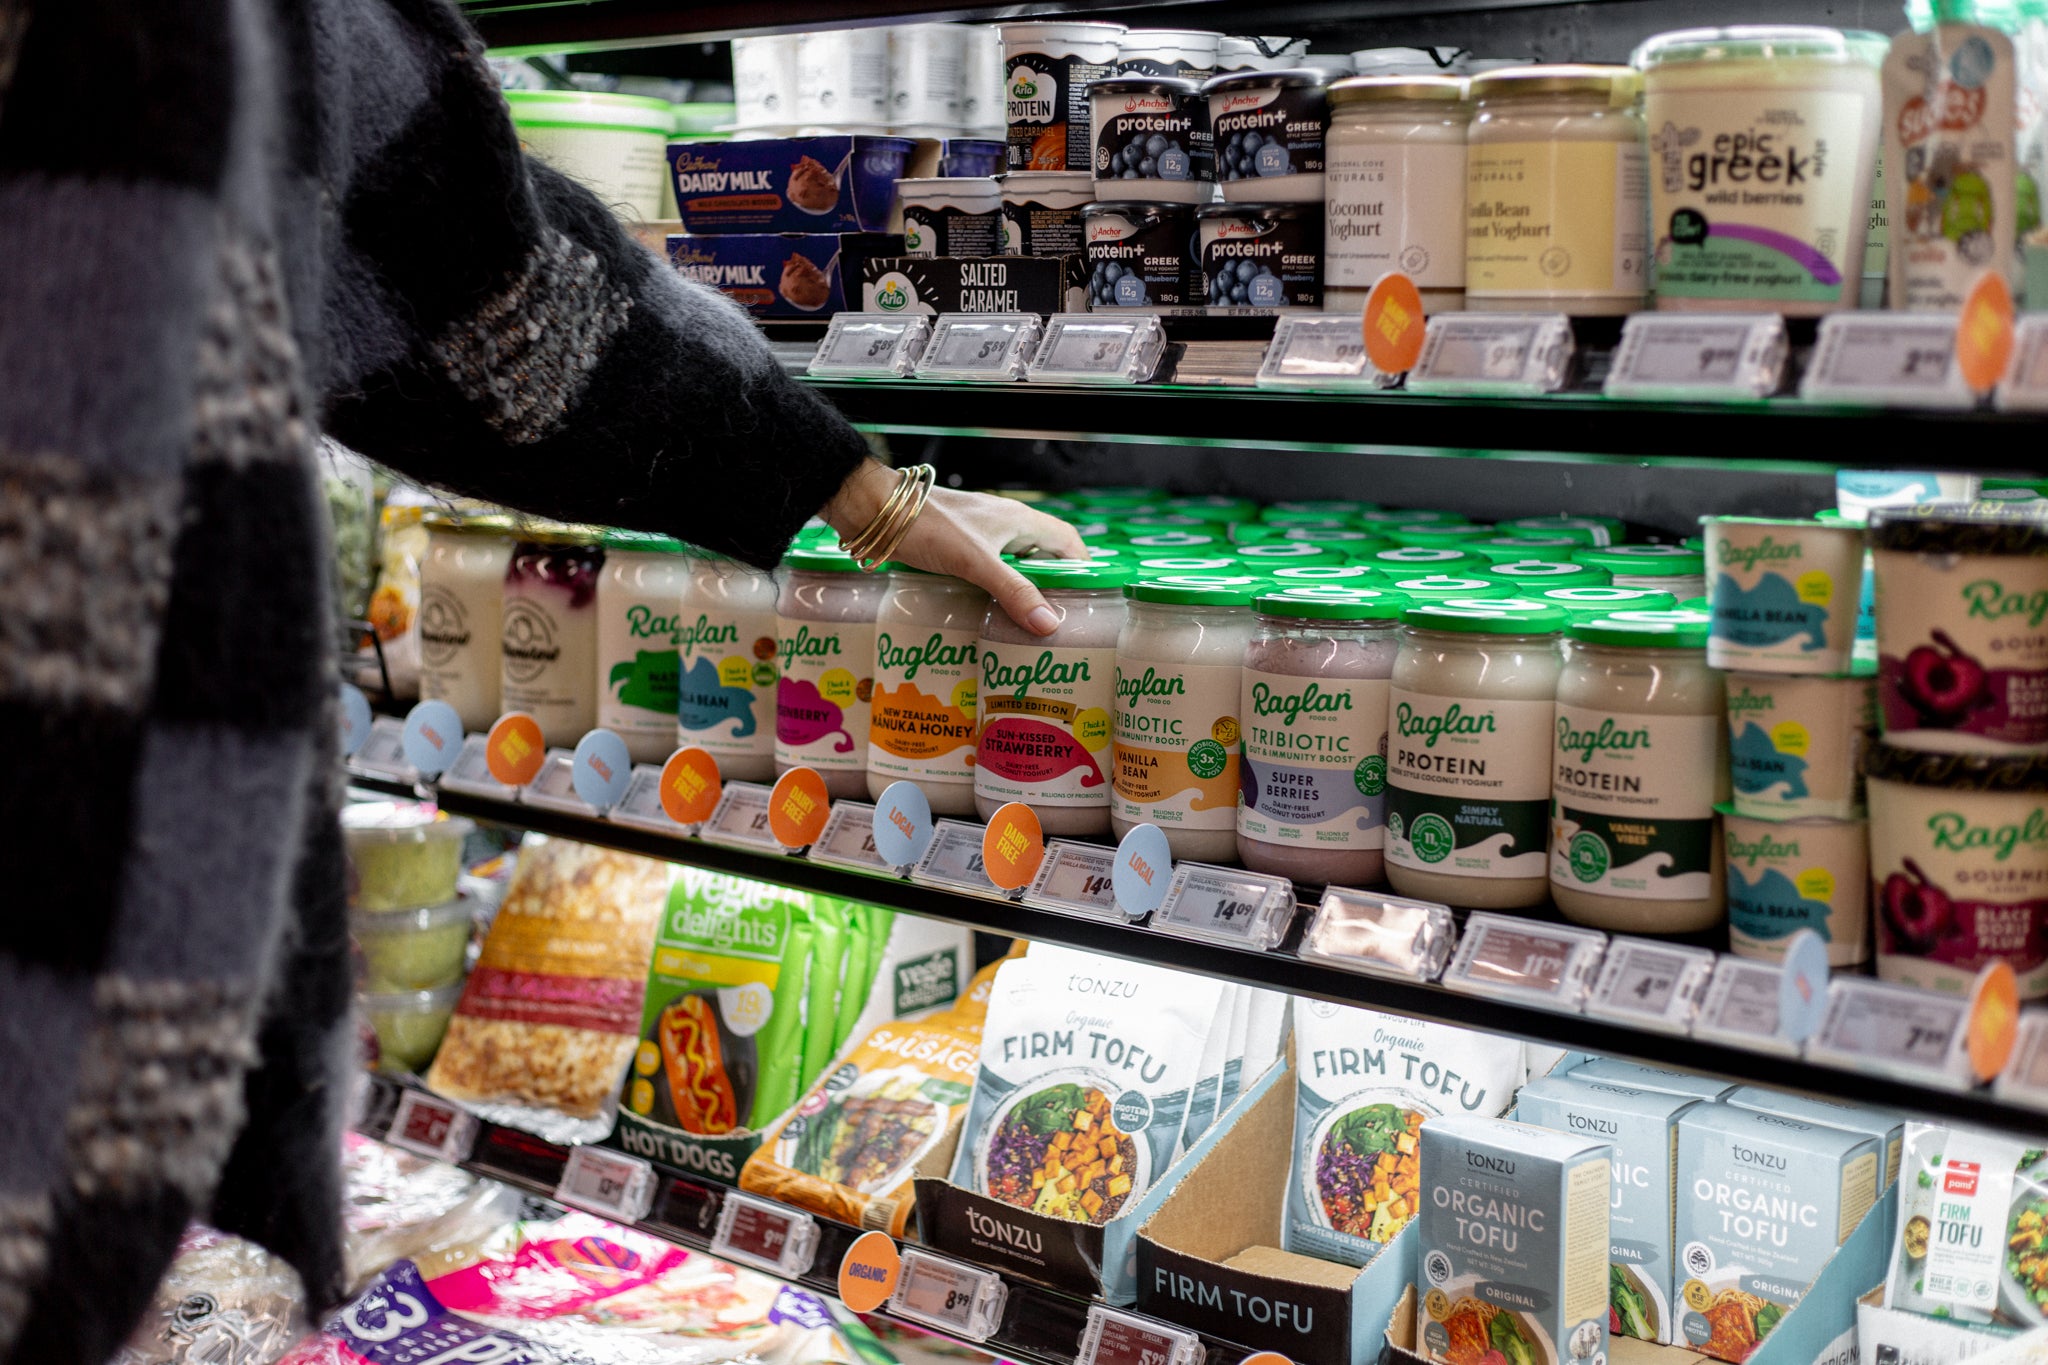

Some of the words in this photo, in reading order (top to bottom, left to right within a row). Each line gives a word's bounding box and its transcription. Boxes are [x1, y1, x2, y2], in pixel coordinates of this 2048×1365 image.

[1014, 85, 1033, 95] Arla
[1008, 100, 1050, 116] PROTEIN
[1138, 97, 1170, 108] Anchor
[1231, 96, 1260, 106] Anchor
[1116, 114, 1191, 134] protein+
[1218, 108, 1286, 134] protein+
[1286, 122, 1321, 132] GREEK
[1024, 126, 1055, 137] CARAMEL
[1288, 142, 1322, 150] Blueberry
[1713, 128, 1773, 157] epic
[675, 152, 721, 173] Cadbury
[1165, 160, 1181, 172] 12g
[1262, 156, 1280, 168] 12g
[1688, 148, 1812, 191] greek
[678, 172, 729, 193] DAIRY
[730, 170, 773, 191] MILK
[1705, 192, 1739, 205] wild
[1743, 189, 1804, 206] berries
[1328, 198, 1384, 216] Coconut
[1495, 202, 1530, 217] Bean
[1098, 228, 1122, 237] Anchor
[1329, 218, 1381, 240] Yoghurt
[1492, 221, 1550, 240] Yoghurt
[1088, 241, 1145, 262] protein+
[1212, 240, 1283, 260] protein+
[1144, 257, 1180, 266] GREEK
[1282, 256, 1315, 264] GREEK
[725, 265, 765, 285] MILK
[960, 263, 1007, 287] SALTED
[1144, 275, 1179, 283] Blueberry
[880, 293, 904, 305] Arla
[1120, 286, 1136, 297] 12g
[1256, 286, 1273, 296] 12g
[960, 290, 1021, 313] CARAMEL
[1718, 536, 1802, 572] Raglan
[1765, 607, 1808, 625] BEAN
[878, 632, 978, 680] Raglan
[930, 668, 949, 676] FOOD
[982, 650, 1090, 700] Raglan
[1115, 666, 1186, 708] Raglan
[990, 699, 1022, 710] LIMITED
[1025, 702, 1068, 716] EDITION
[1252, 682, 1353, 726] Raglan
[884, 707, 900, 718] NEW
[902, 710, 949, 723] ZEALAND
[920, 722, 973, 738] HONEY
[1082, 720, 1100, 729] Thick
[1082, 728, 1106, 738] Creamy
[1397, 702, 1496, 748] Raglan
[996, 729, 1056, 743] SUN-KISSED
[1156, 736, 1186, 746] BOOST
[1252, 727, 1350, 752] TRIBIOTIC
[1558, 716, 1651, 763] Raglan
[986, 738, 1074, 758] STRAWBERRY
[1192, 740, 1224, 756] PROBIOTICS
[1249, 746, 1261, 755] GUT
[1269, 750, 1316, 762] IMMUNITY
[1320, 754, 1353, 763] BOOST
[1006, 761, 1039, 770] DAIRY-FREE
[1118, 750, 1158, 768] VANILLA
[1200, 754, 1214, 764] 3x
[1398, 750, 1486, 776] PROTEIN
[680, 763, 708, 793] DAIRY
[995, 762, 1023, 777] COCONUT
[1024, 767, 1053, 777] YOGHURT
[1122, 766, 1148, 780] BEAN
[1366, 769, 1380, 781] 3x
[1559, 765, 1641, 792] PROTEIN
[1272, 772, 1314, 786] SUPER
[1403, 770, 1420, 780] STYLE
[1421, 773, 1459, 785] COCONUT
[1462, 777, 1503, 788] YOGHURT
[672, 777, 699, 804] FREE
[788, 785, 818, 814] DAIRY
[1006, 788, 1022, 796] SUGAR
[1134, 790, 1161, 798] YOGHURT
[1267, 784, 1320, 801] BERRIES
[780, 798, 807, 826] FREE
[1261, 803, 1290, 818] COCONUT
[1291, 810, 1325, 819] YOGHURT
[1273, 800, 1310, 812] DAIRY-FREE
[1461, 805, 1499, 816] SIMPLY
[888, 806, 915, 840] LOCAL
[1455, 815, 1504, 826] NATURAL
[1609, 822, 1657, 836] VANILLA
[1003, 822, 1030, 854] DAIRY
[1616, 834, 1648, 846] VIBES
[1927, 807, 2048, 862] Ragl
[996, 838, 1021, 865] FREE
[1128, 852, 1156, 886] LOCAL
[1767, 902, 1810, 920] BEAN
[1975, 908, 2032, 923] BLACK
[672, 904, 777, 951] delights
[1978, 934, 2026, 949] PLUM
[1065, 1010, 1114, 1032] Organic
[1374, 1028, 1424, 1051] Organic
[1003, 1030, 1074, 1063] FIRM
[1089, 1031, 1168, 1084] TOFU
[1313, 1048, 1386, 1078] FIRM
[1400, 1052, 1487, 1111] TOFU
[1115, 1104, 1149, 1116] PROTEIN
[1120, 1113, 1139, 1122] RICH
[621, 1125, 664, 1156] HOT
[672, 1141, 736, 1179] DOGS
[1459, 1176, 1520, 1198] CERTIFIED
[1725, 1171, 1791, 1194] CERTIFIED
[1948, 1177, 1974, 1190] pams
[1433, 1186, 1545, 1232] ORGANIC
[1694, 1179, 1818, 1228] ORGANIC
[1939, 1202, 1972, 1222] FIRM
[1455, 1218, 1519, 1254] TOFU
[1719, 1210, 1788, 1247] TOFU
[1937, 1220, 1983, 1248] TOFU
[848, 1262, 887, 1284] ORGANIC
[945, 1290, 970, 1310] 899
[1154, 1266, 1224, 1312] FIRM
[1230, 1290, 1314, 1334] TOFU
[1486, 1287, 1536, 1308] ORIGINAL
[1100, 1338, 1114, 1348] TOFU
[1115, 1342, 1131, 1353] FIRM
[1142, 1331, 1163, 1344] SPECIAL
[1138, 1348, 1165, 1365] 599
